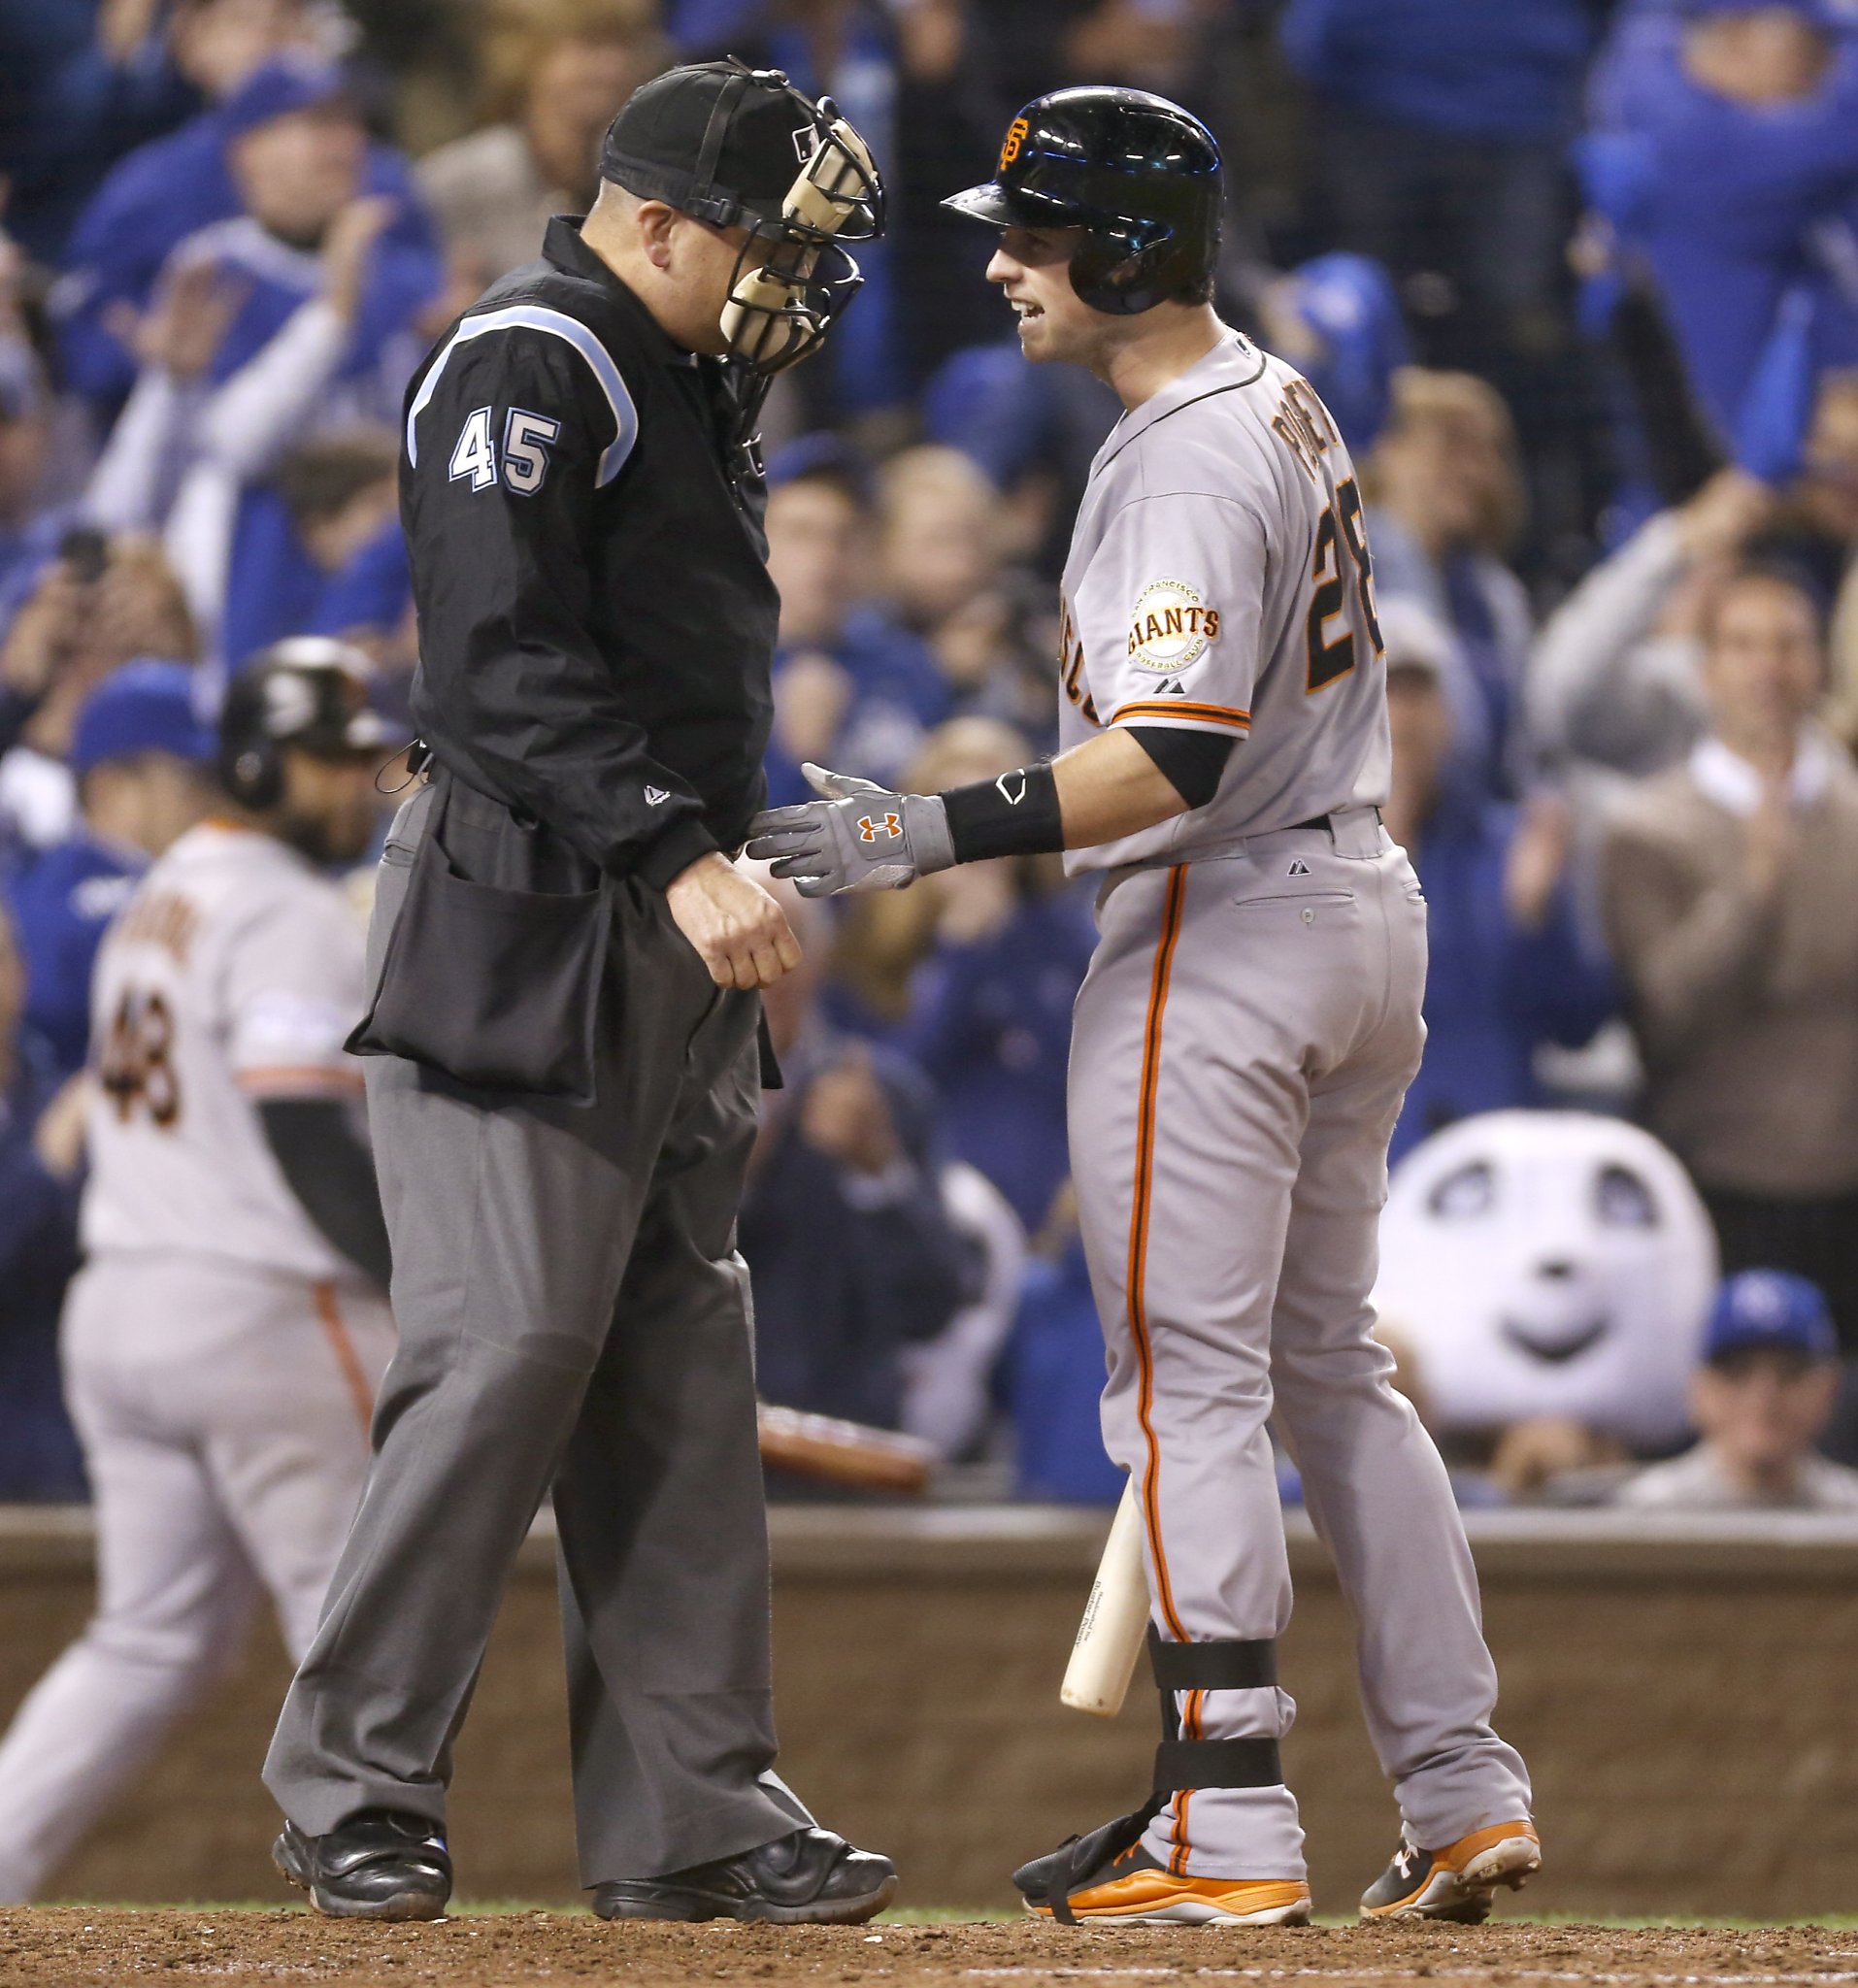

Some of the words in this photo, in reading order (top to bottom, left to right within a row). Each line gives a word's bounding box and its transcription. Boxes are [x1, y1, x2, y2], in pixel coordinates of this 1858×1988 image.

[448, 405, 561, 497] 45
[1144, 580, 1200, 603] FRANCISCO
[1127, 607, 1220, 656] GIANTS
[1183, 638, 1204, 662] CLUB
